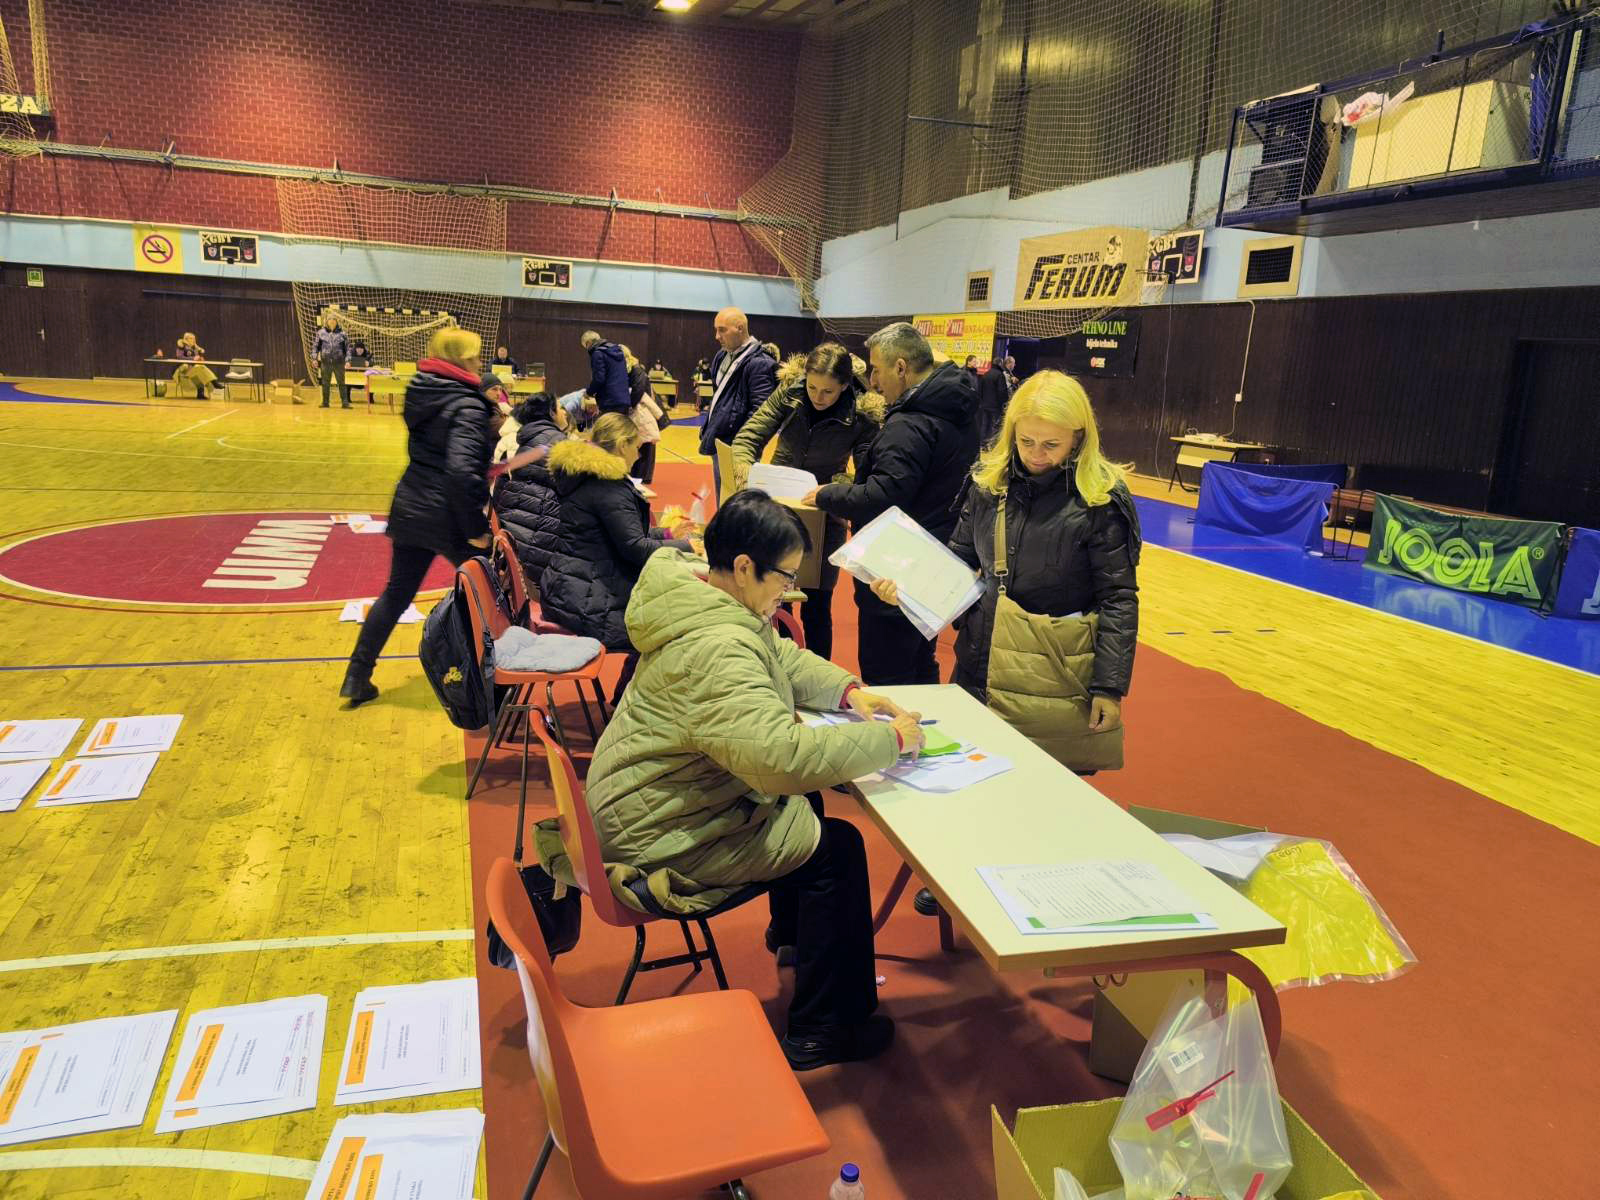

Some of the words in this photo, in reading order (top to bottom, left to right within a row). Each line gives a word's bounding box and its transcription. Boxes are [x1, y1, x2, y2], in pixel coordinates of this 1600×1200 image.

[1067, 252, 1100, 265] CENTAR
[1024, 254, 1127, 301] FERUM
[1108, 321, 1127, 335] LINE
